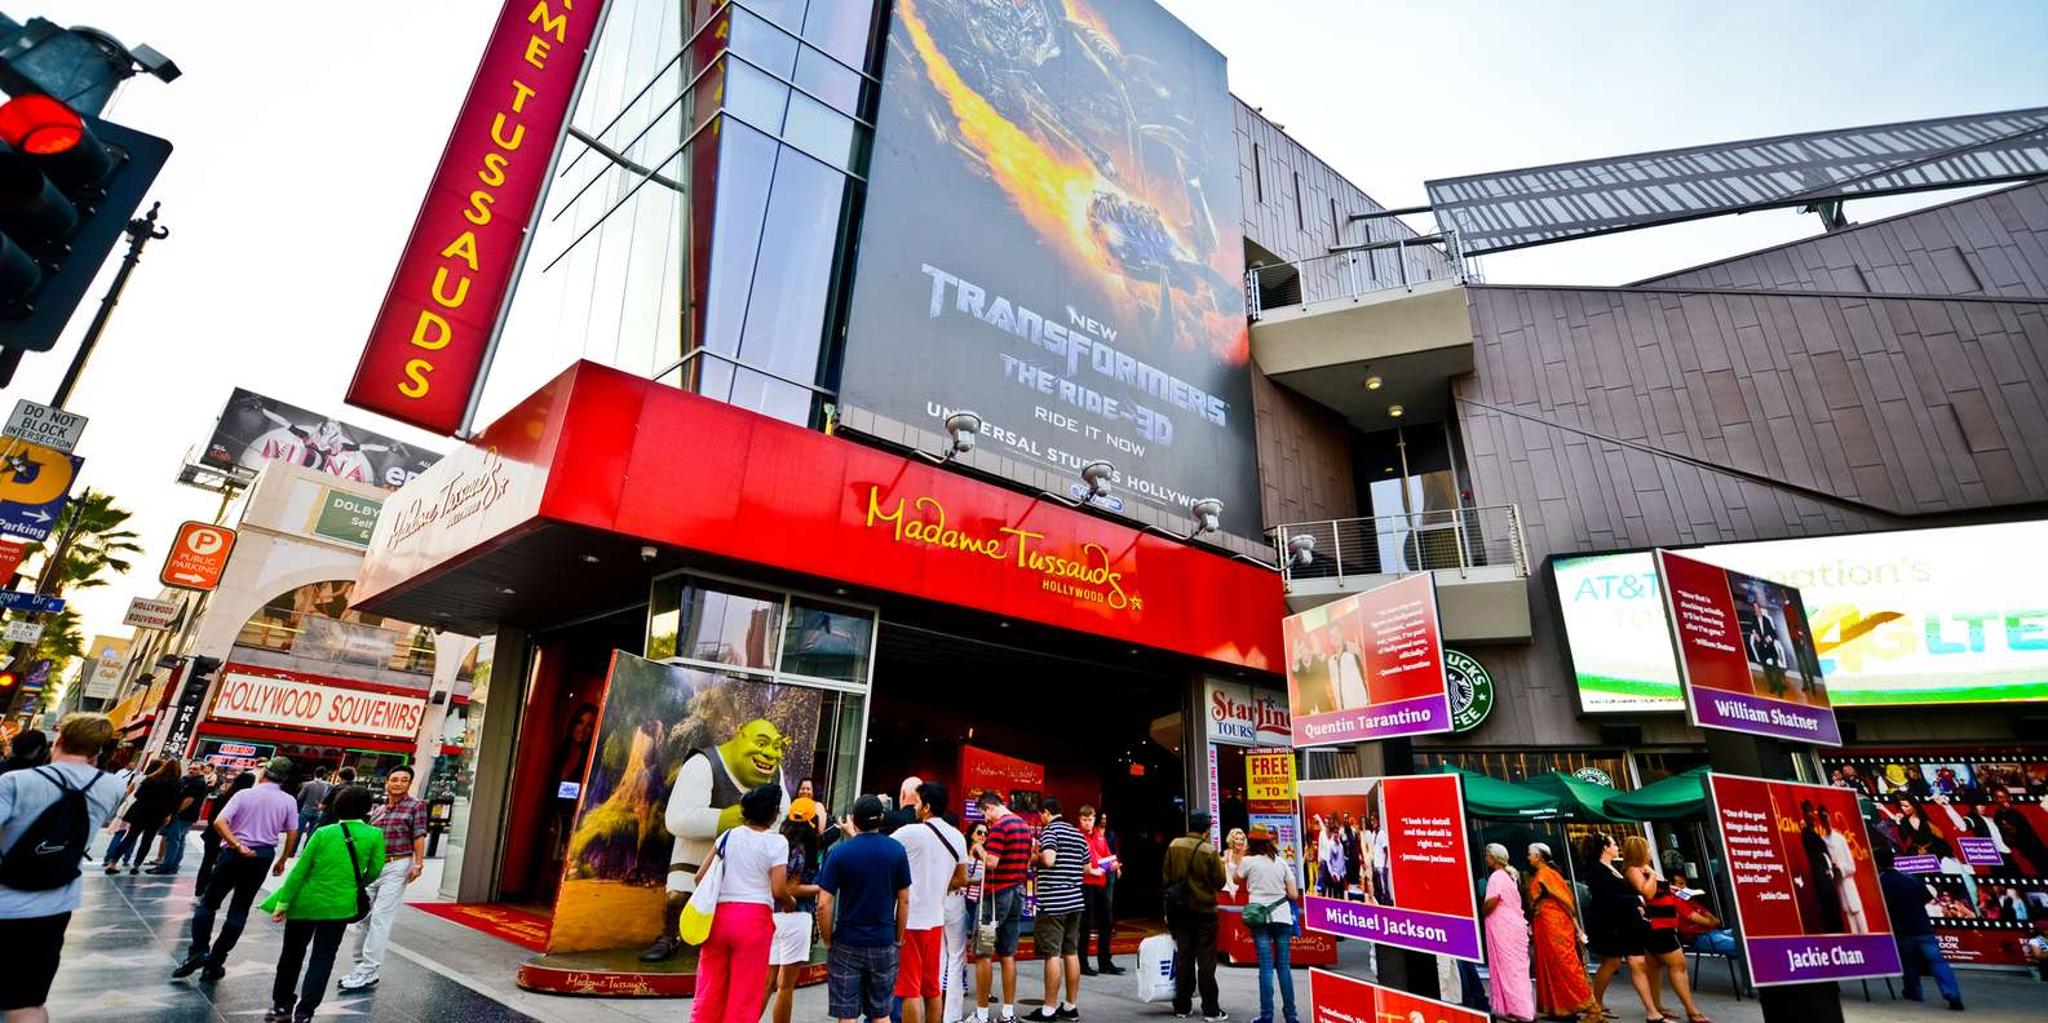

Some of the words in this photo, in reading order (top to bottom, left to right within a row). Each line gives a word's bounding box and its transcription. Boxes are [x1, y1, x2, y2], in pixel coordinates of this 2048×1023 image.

[524, 0, 573, 69] ME
[397, 80, 536, 399] TUSSAUDS
[1068, 306, 1118, 342] NEW
[921, 263, 1228, 427] TRANSFORMERS
[1001, 353, 1057, 394] THE
[21, 418, 67, 438] BLOCK
[24, 404, 44, 418] DO
[50, 412, 78, 427] NOT
[7, 425, 72, 448] INTERSECTION
[927, 401, 1041, 457] UNERSAL
[1047, 448, 1120, 483] STUS
[1035, 406, 1078, 433] RIDE
[1085, 424, 1102, 440] IT
[1107, 433, 1146, 458] NOW
[334, 498, 381, 516] DOLBY
[0, 519, 46, 538] Parking
[195, 533, 217, 549] P
[180, 553, 216, 565] PUBLIC
[867, 486, 1007, 559] Madame
[1000, 527, 1127, 610] Tussauds
[172, 560, 217, 574] PARKING
[1042, 580, 1104, 602] HOLLYWOOD
[1574, 565, 1658, 602] AT&T
[133, 602, 174, 615] HOLLYWOOD
[217, 680, 322, 719] HOLLYWOOD
[328, 694, 420, 731] SOUVENIRS
[1714, 699, 1770, 724] William
[1770, 709, 1818, 731] Shatner
[1217, 722, 1253, 738] TOURS
[1305, 718, 1355, 740] Quentin
[1357, 708, 1431, 729] Tarantino
[1251, 757, 1289, 775] FREE
[1265, 787, 1280, 796] TO
[1325, 907, 1380, 931] Michael
[1383, 916, 1448, 943] Jackson
[1787, 947, 1830, 972] Jackie
[1831, 946, 1865, 966] Chan
